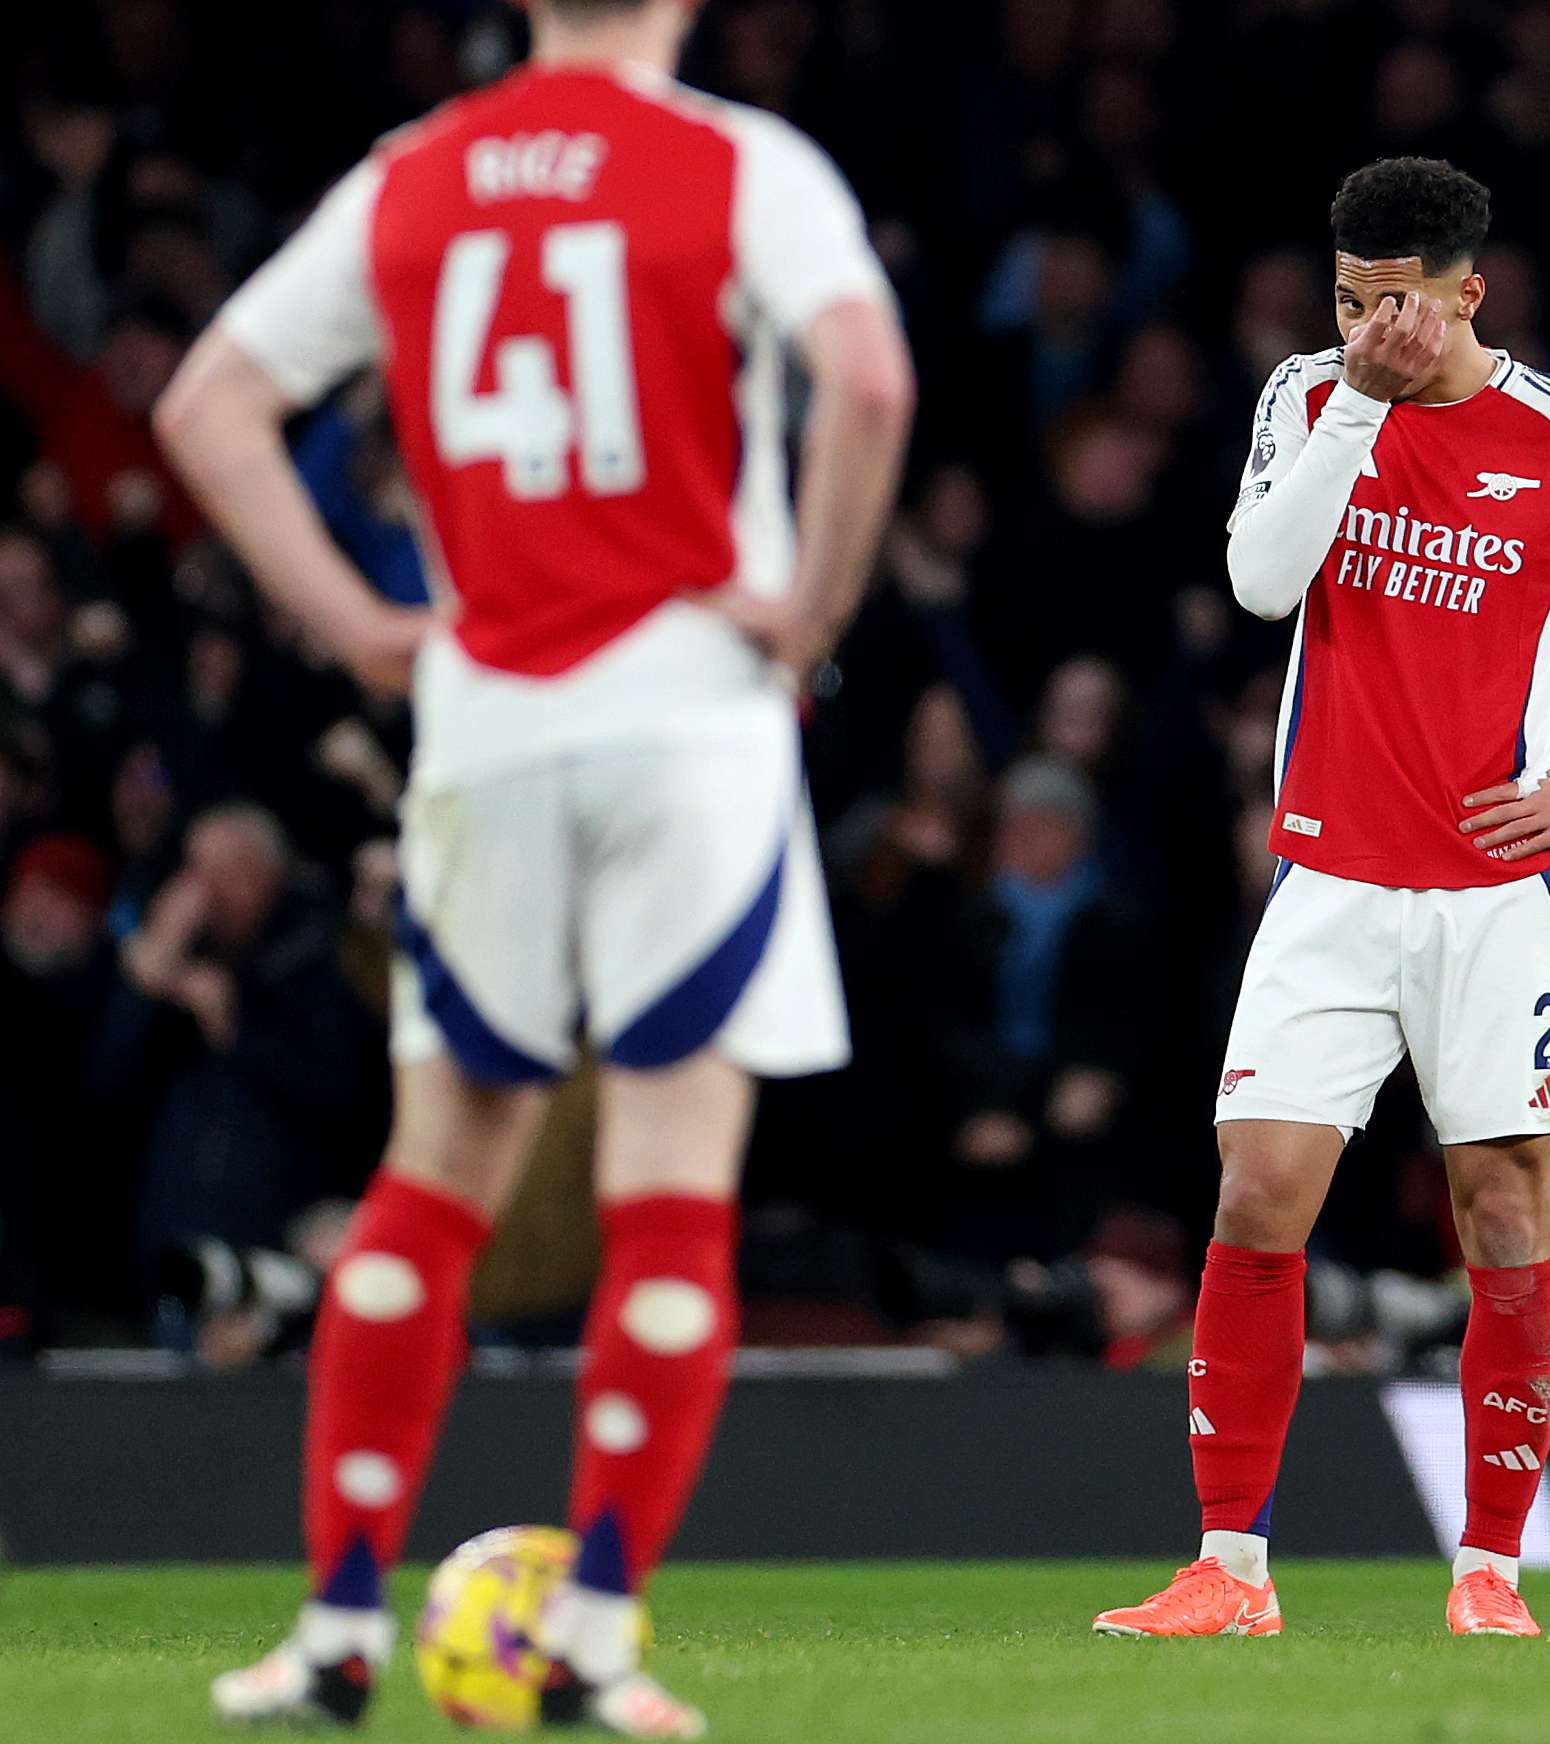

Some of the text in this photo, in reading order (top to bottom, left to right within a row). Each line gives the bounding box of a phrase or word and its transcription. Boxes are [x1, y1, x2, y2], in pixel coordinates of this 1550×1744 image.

[465, 130, 610, 206] RICE
[430, 219, 648, 500] 41
[1337, 504, 1525, 575] mirates
[1337, 549, 1487, 614] FLY BETTER
[1483, 1392, 1549, 1424] AFC
